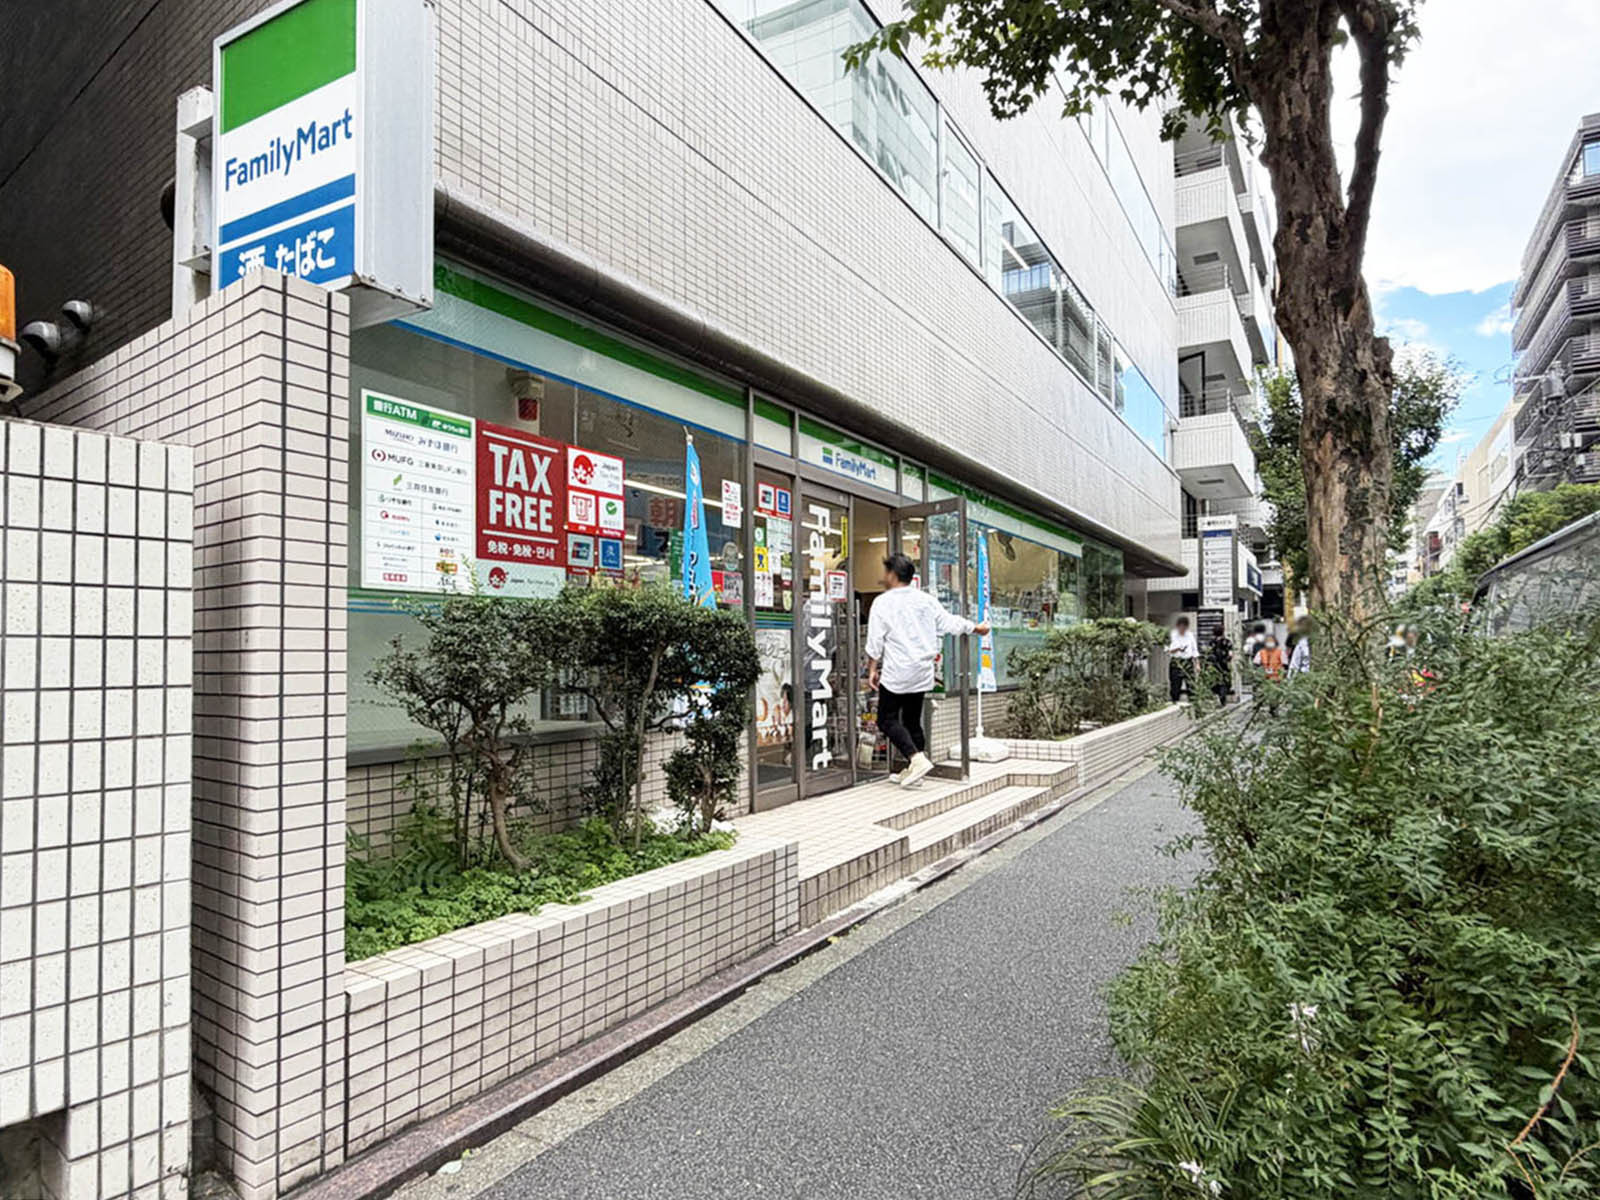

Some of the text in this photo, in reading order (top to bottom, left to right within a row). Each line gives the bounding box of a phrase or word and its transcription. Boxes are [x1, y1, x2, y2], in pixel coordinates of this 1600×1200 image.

[225, 107, 353, 192] FamilyMart
[275, 227, 336, 277] たばこ
[388, 453, 414, 466] MUFG
[488, 442, 553, 496] TAX
[835, 452, 877, 480] FamilyMart
[488, 489, 553, 534] FREE
[807, 503, 833, 771] FamilyMart
